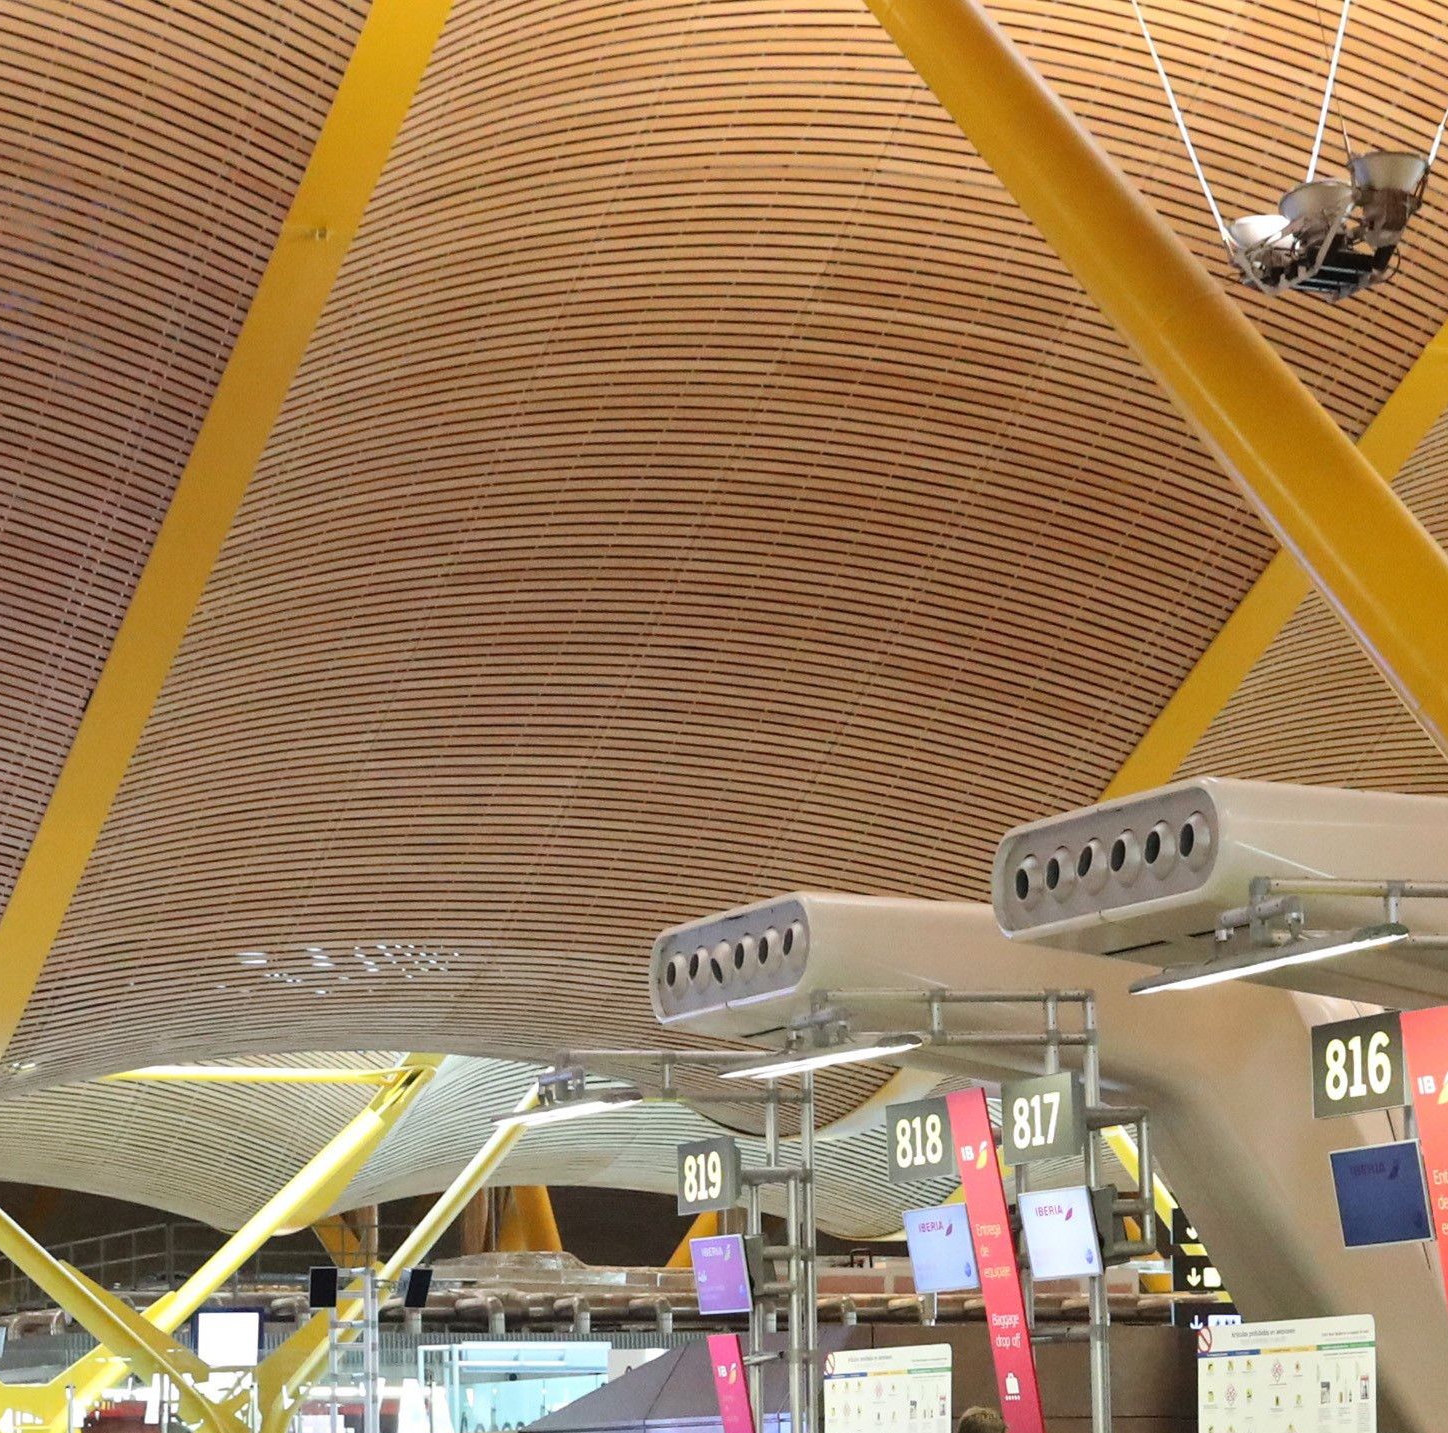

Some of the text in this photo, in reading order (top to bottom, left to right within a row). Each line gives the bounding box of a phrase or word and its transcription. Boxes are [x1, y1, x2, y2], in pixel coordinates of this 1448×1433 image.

[1324, 1030, 1392, 1101] 816
[1416, 1074, 1437, 1095] IB
[1012, 1091, 1060, 1150] 817
[895, 1113, 944, 1169] 818
[960, 1144, 975, 1162] IB
[683, 1150, 722, 1203] 819
[917, 1220, 944, 1234] IBERIA
[1034, 1204, 1064, 1218] IBERIA
